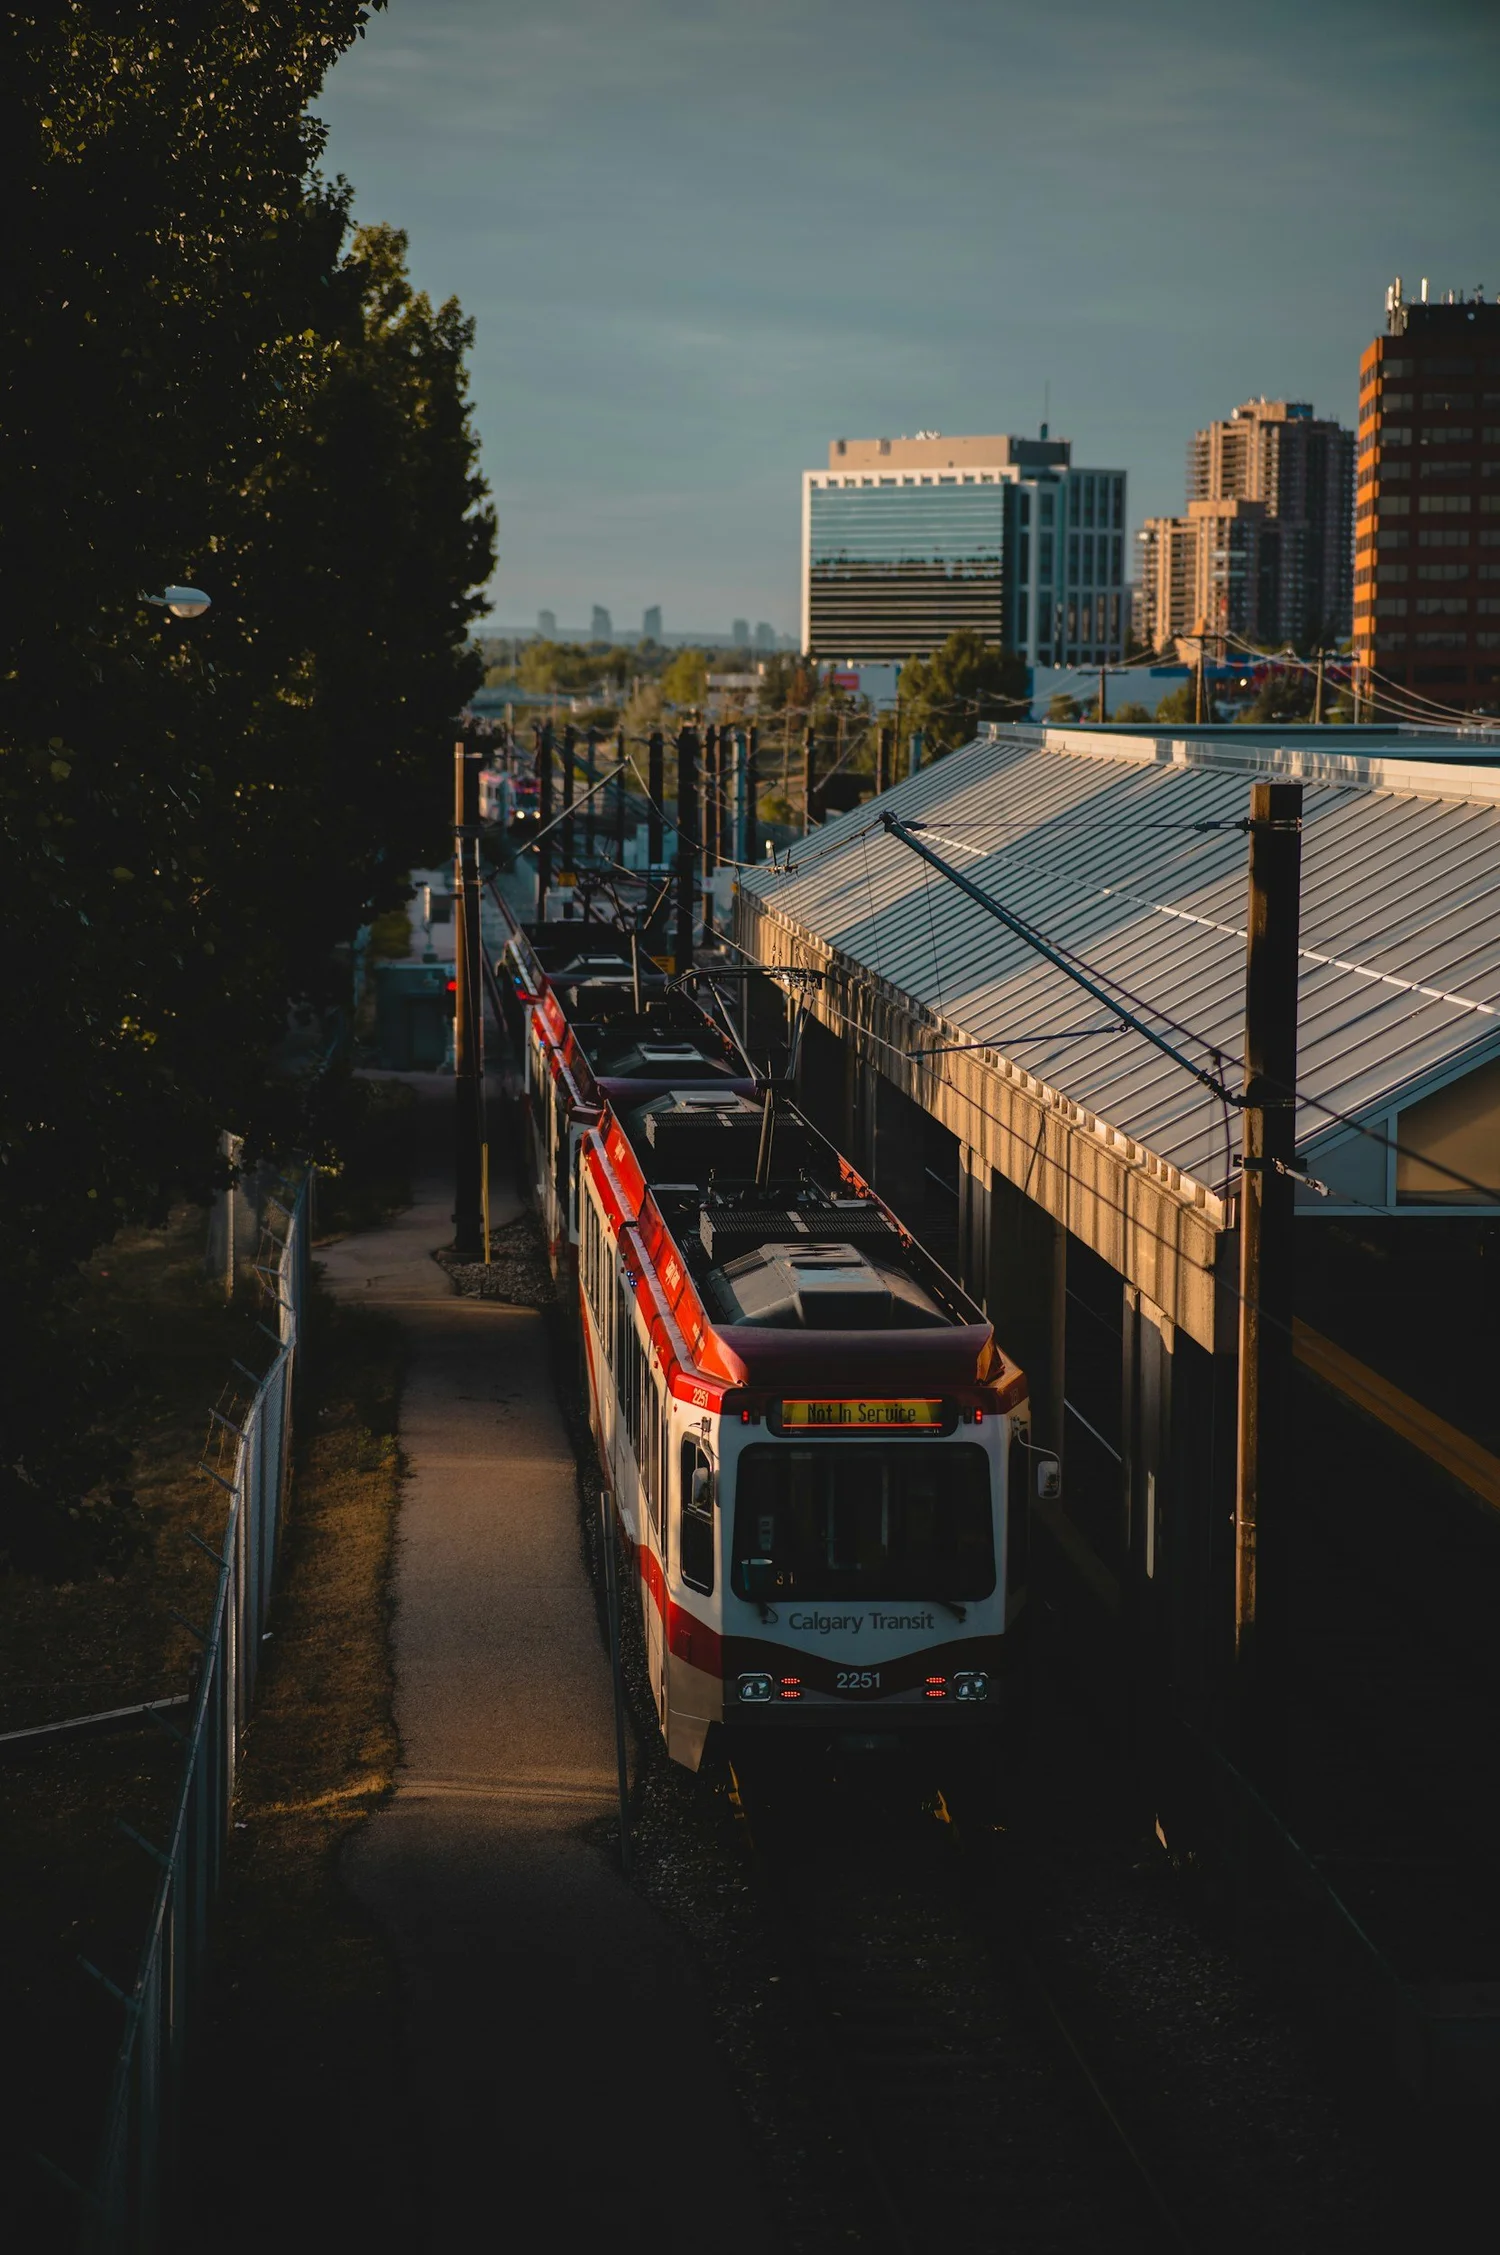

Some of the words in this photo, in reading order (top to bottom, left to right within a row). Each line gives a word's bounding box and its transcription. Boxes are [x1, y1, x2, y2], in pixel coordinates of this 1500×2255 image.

[692, 1387, 709, 1408] 2251
[807, 1403, 832, 1423] Not
[839, 1402, 852, 1423] In
[858, 1403, 916, 1423] Service
[789, 1611, 864, 1635] Calgary
[868, 1611, 935, 1630] Transit
[836, 1672, 881, 1689] 2251
